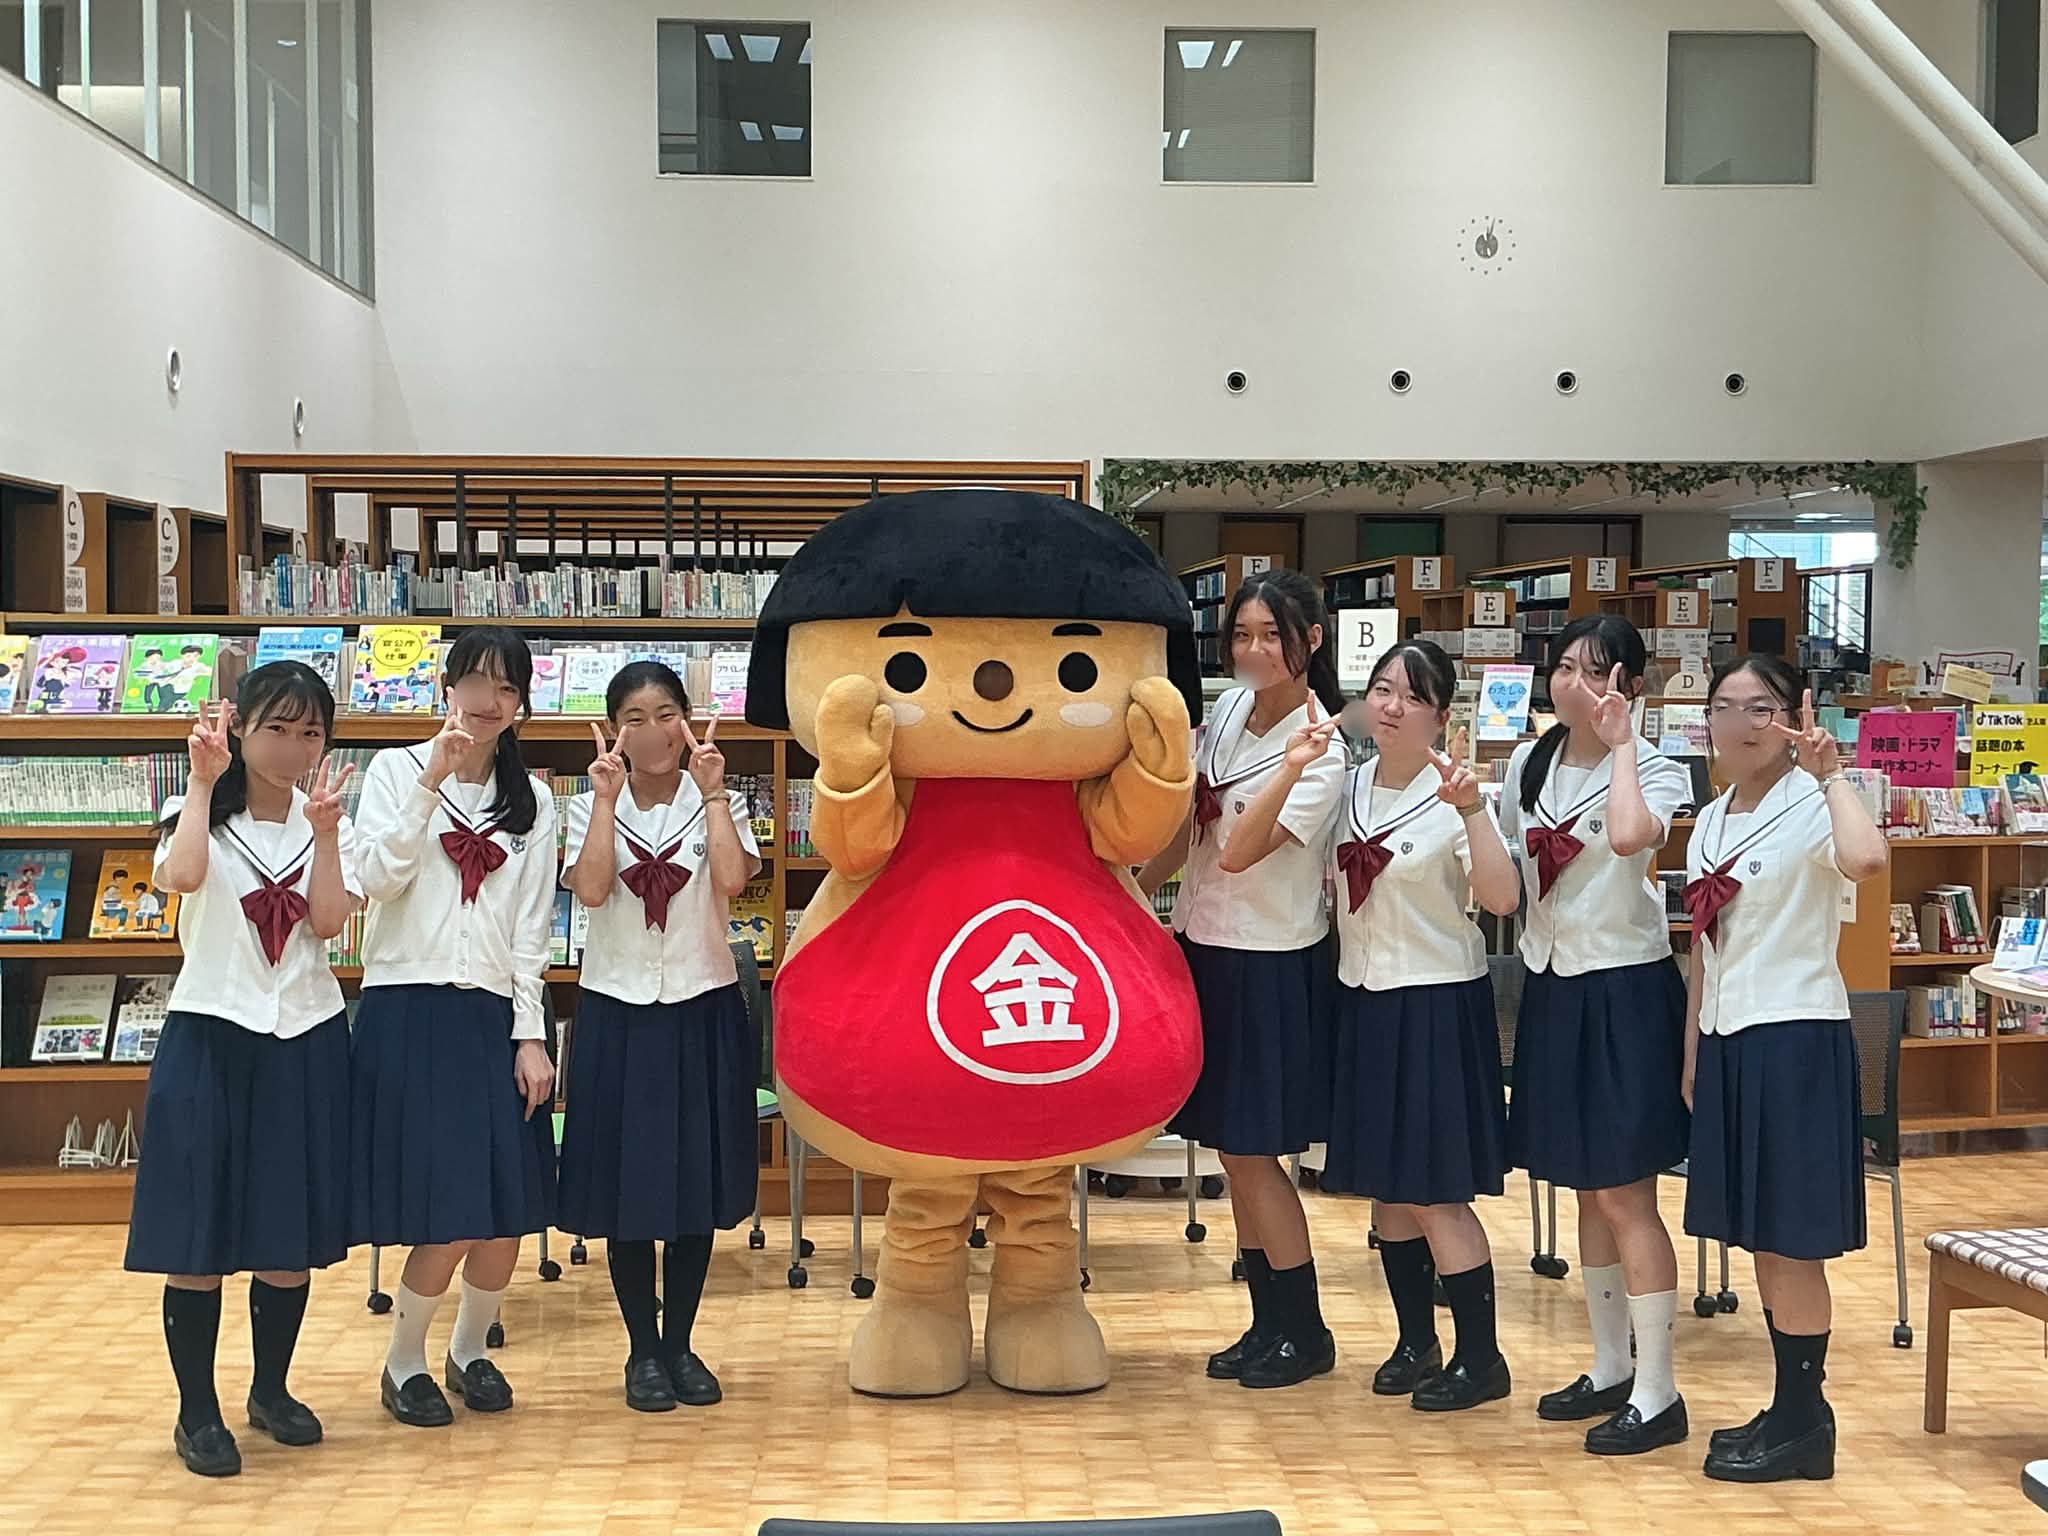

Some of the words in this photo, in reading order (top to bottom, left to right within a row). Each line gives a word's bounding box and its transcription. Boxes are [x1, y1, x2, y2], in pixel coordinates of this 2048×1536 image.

[67, 501, 77, 526] C
[161, 517, 171, 541] C
[1250, 558, 1263, 575] F
[1421, 559, 1433, 575] F
[1596, 559, 1608, 576] F
[1764, 560, 1776, 577] F
[1484, 596, 1497, 613] E
[1677, 596, 1689, 613] E
[1357, 621, 1375, 648] B
[1682, 675, 1695, 689] D
[1988, 713, 2023, 726] TikTok
[1870, 736, 1941, 754] 映画・ドラマ
[1975, 739, 2025, 753] 話題の本
[1975, 764, 2009, 775] コーナー
[969, 932, 1085, 1047] 金
